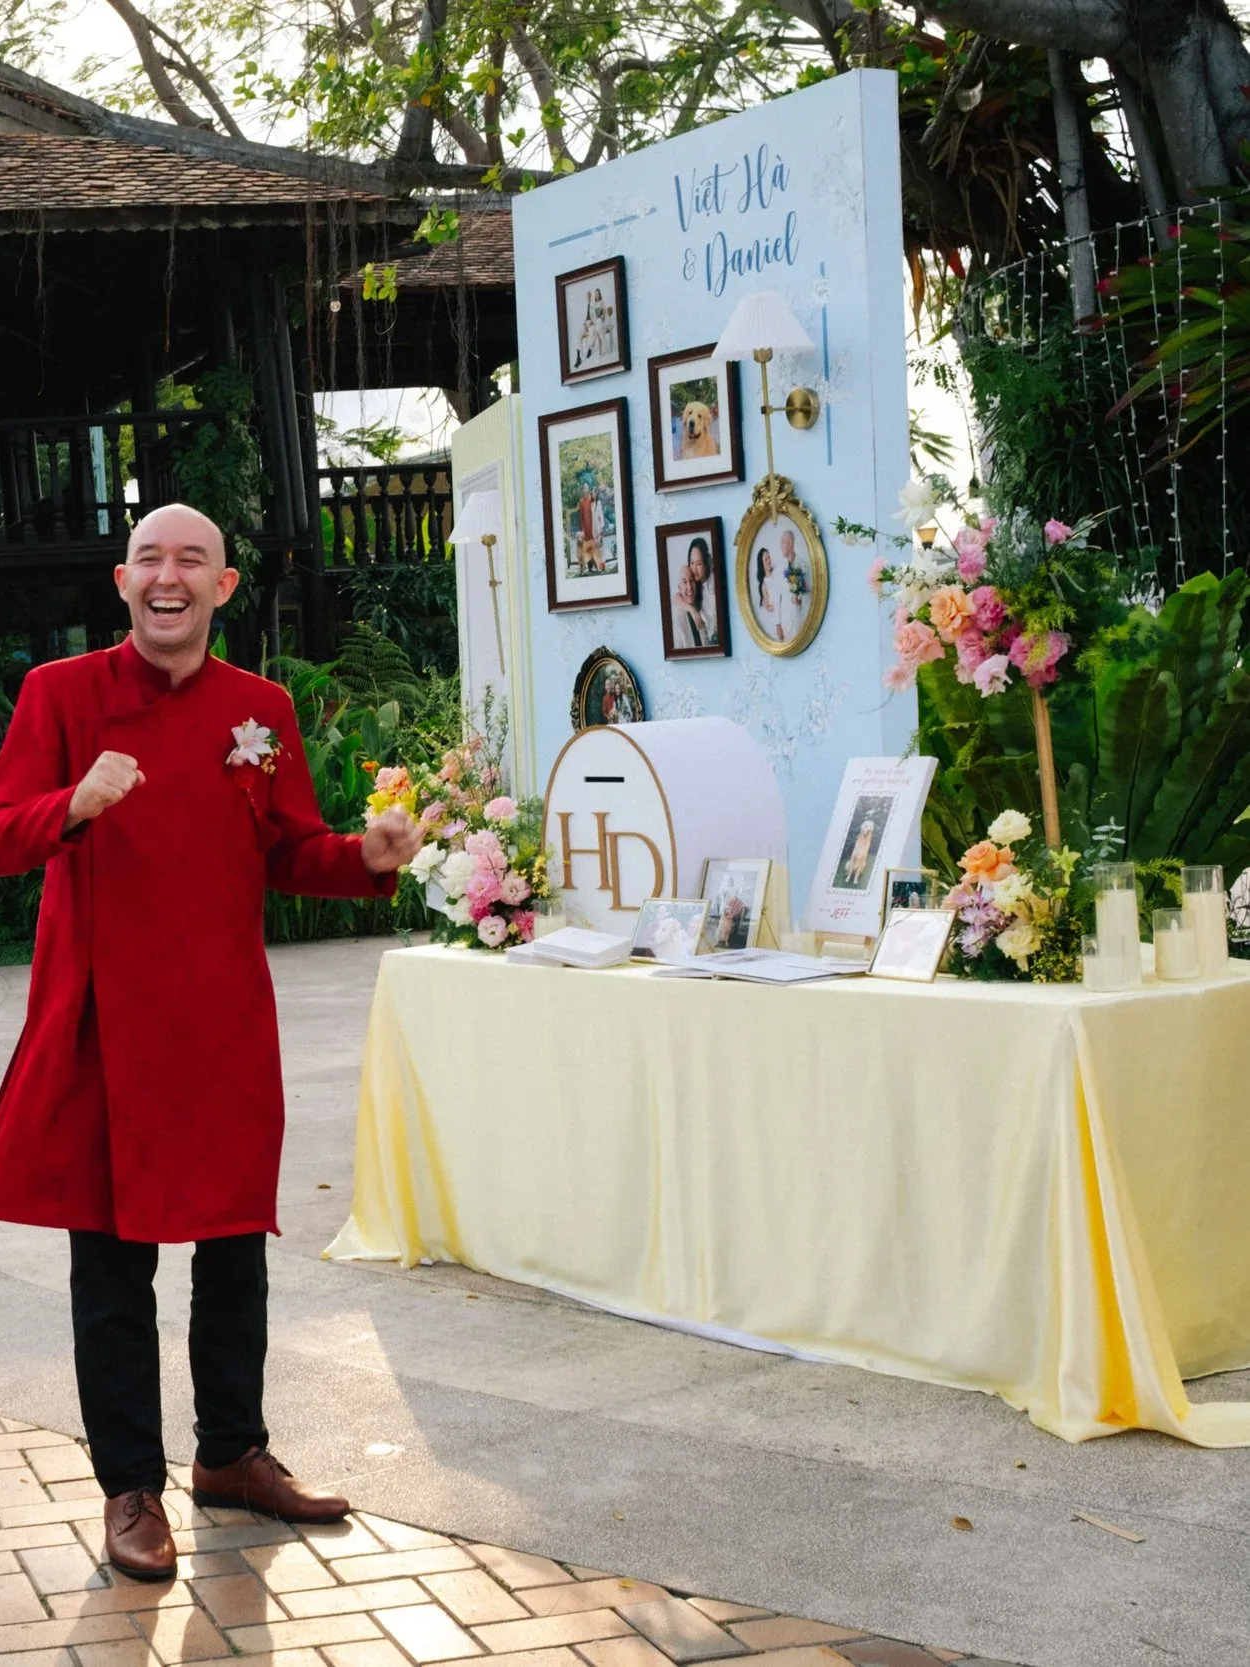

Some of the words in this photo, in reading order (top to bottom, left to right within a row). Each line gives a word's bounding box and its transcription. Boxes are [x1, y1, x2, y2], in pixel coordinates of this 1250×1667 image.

[675, 163, 738, 232] Việt
[738, 143, 790, 214] Hà
[683, 248, 696, 281] &
[706, 211, 800, 298] Daniel
[830, 907, 851, 920] JEFF
